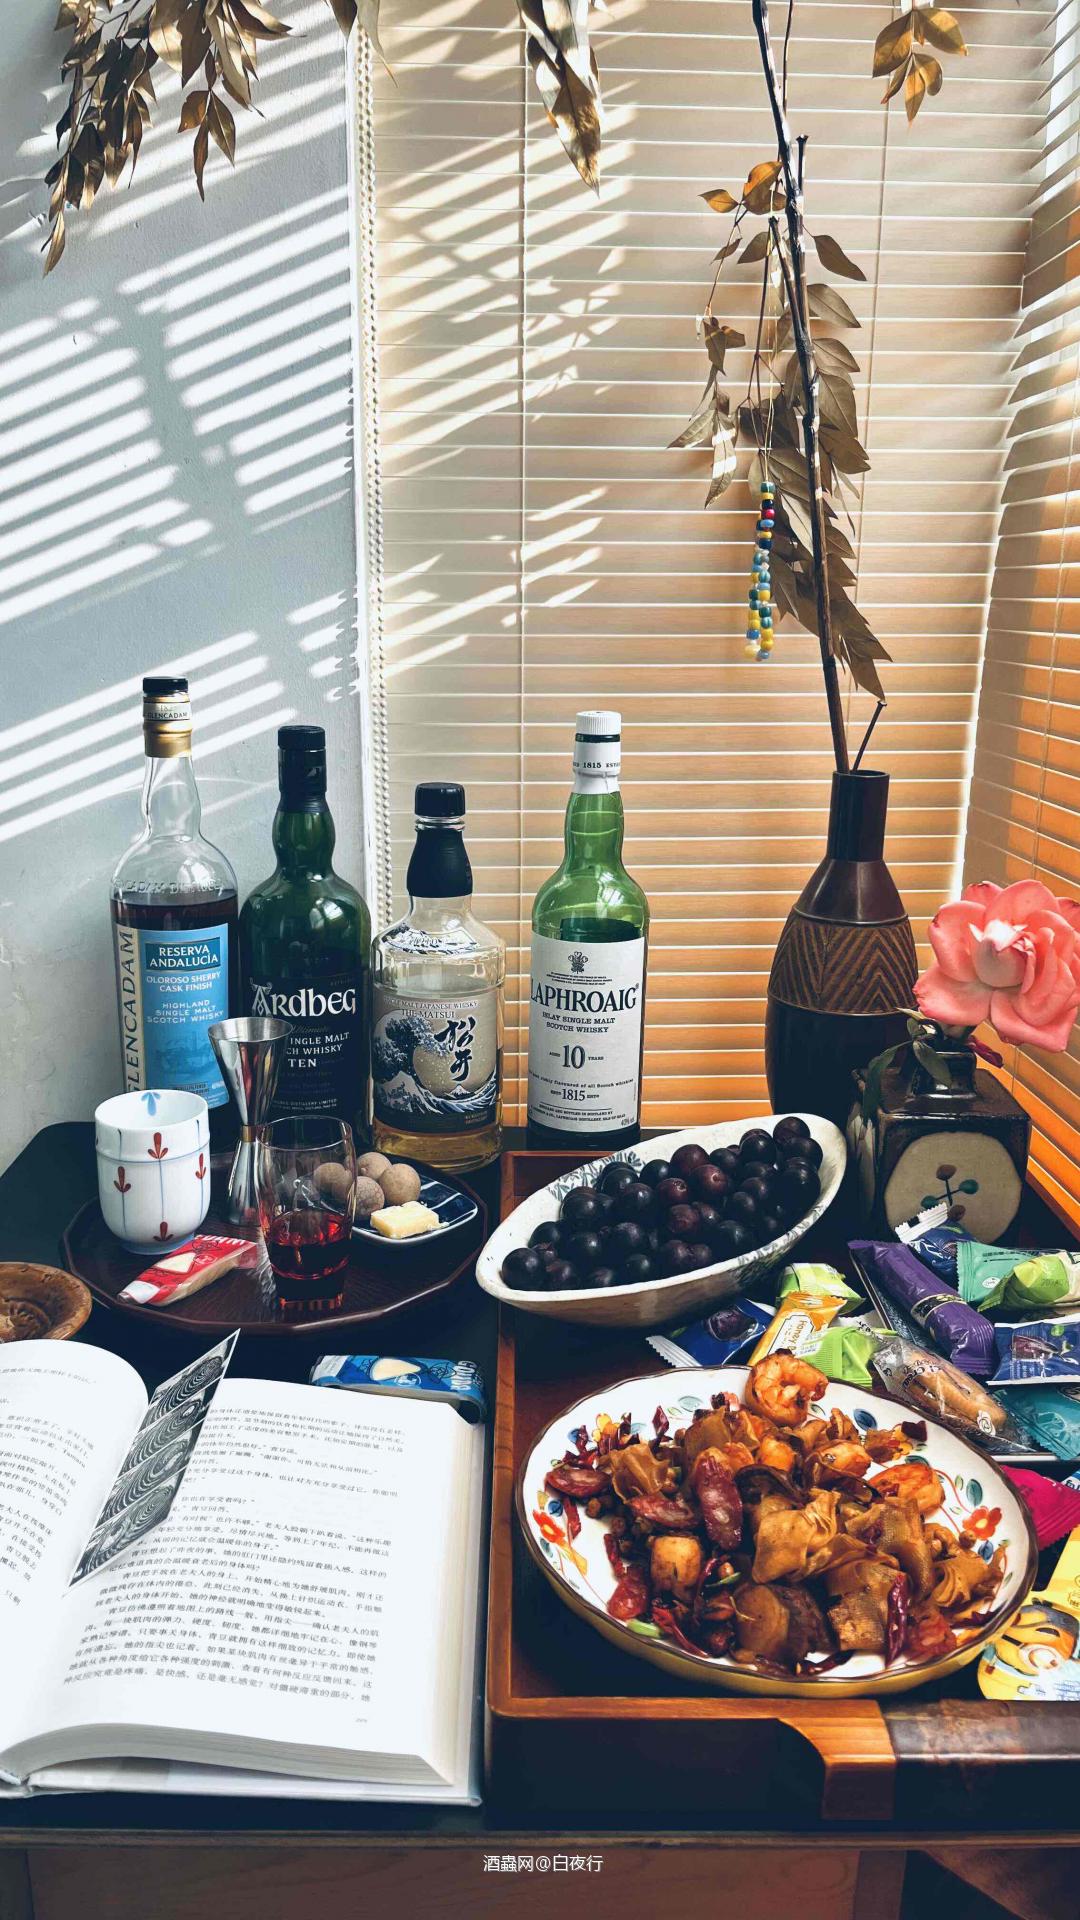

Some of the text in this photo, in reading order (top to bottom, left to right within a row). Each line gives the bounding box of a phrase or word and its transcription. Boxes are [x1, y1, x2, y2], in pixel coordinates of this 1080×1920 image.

[159, 944, 210, 957] RESERVA
[149, 953, 219, 968] ANDALUCÍA
[146, 972, 221, 984] OLOROSO SHERRY
[159, 983, 213, 993] CASK FINISH
[162, 1000, 210, 1009] HIGHLAND
[194, 1005, 216, 1014] MALT
[147, 1010, 224, 1024] SCOTCH WHISKY
[401, 1009, 455, 1018] THE MATSUI
[543, 1012, 560, 1020] ISLAY
[546, 1022, 574, 1031] SCOTCH
[289, 1032, 350, 1045] INGLE MALT
[303, 1044, 343, 1055] WHISKY
[562, 1044, 586, 1069] 10
[287, 1059, 317, 1068] TEN
[562, 1088, 586, 1101] 1815
